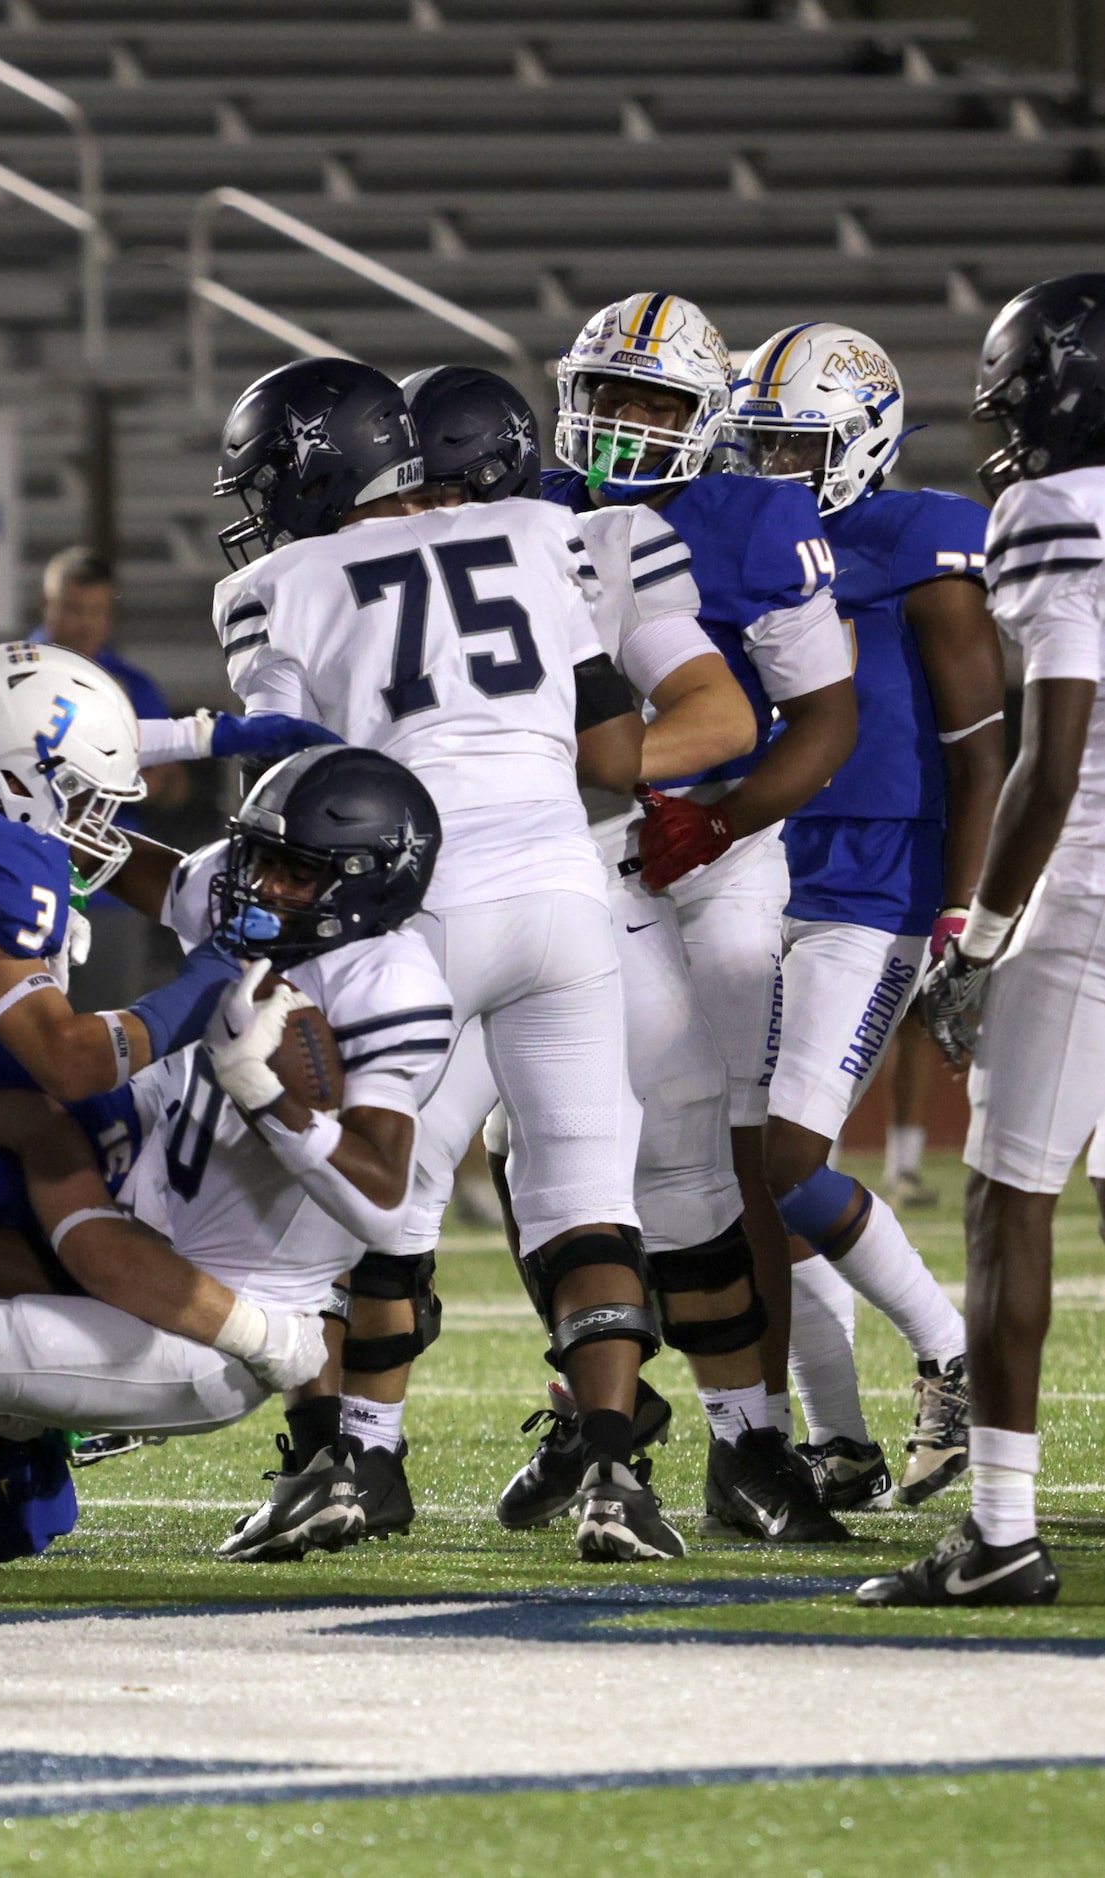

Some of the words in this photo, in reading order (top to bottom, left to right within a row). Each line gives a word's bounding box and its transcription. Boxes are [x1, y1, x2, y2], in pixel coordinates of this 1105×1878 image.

[822, 345, 897, 393] Frisco
[796, 538, 836, 597] 14
[342, 535, 547, 722] 75
[33, 694, 79, 751] 3
[16, 885, 57, 951] 3
[839, 956, 916, 1081] RACCOONS
[329, 1482, 357, 1498] NIKE
[870, 1474, 887, 1496] 27
